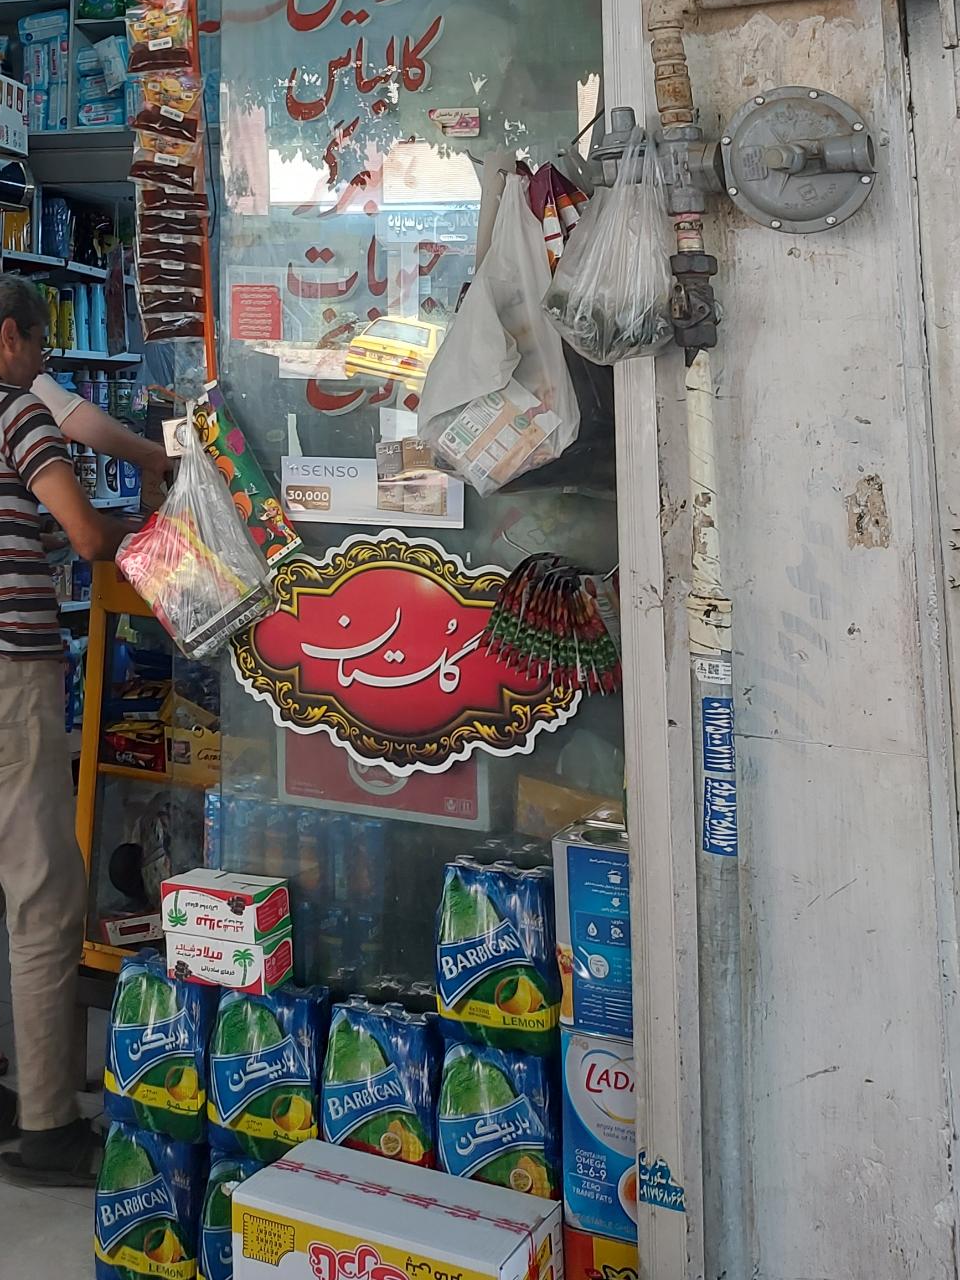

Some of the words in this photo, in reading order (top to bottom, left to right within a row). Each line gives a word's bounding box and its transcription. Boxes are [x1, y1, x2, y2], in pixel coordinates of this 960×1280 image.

[286, 15, 445, 121] کالباس
[288, 490, 329, 502] 30,000
[301, 607, 485, 692] گلستان
[196, 946, 223, 962] میلاد
[441, 931, 521, 980] BARBICAN
[502, 1014, 545, 1029] LEMON
[327, 1078, 403, 1120] BARBICAN
[576, 1156, 607, 1169] OMEGA
[576, 1164, 607, 1181] 3-6-9
[572, 1186, 595, 1199] TRANS
[582, 1181, 600, 1191] ZERO
[100, 1186, 169, 1227] BARBICAN
[148, 1263, 184, 1278] LEMON
